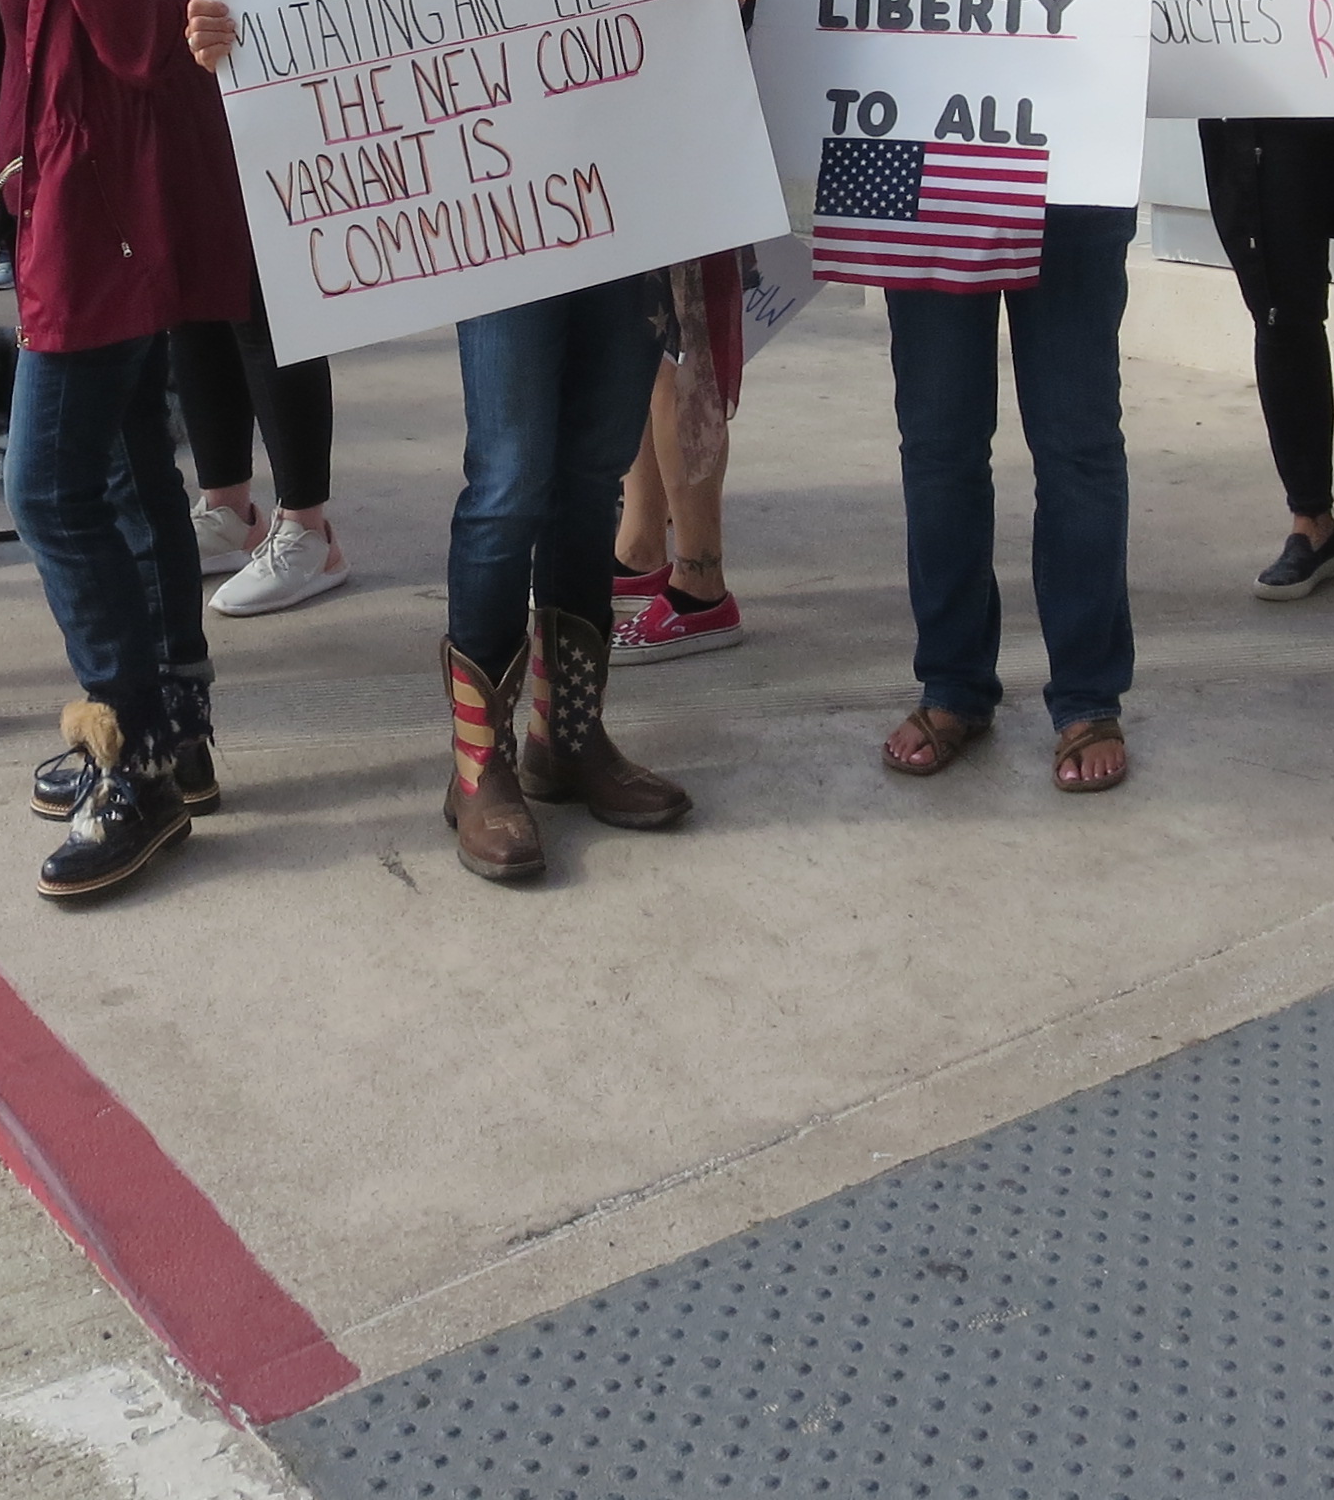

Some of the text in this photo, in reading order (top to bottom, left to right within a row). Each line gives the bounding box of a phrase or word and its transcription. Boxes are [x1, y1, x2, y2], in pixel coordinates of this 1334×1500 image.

[301, 12, 646, 144] THE NEW COVID
[825, 88, 1049, 147] TO ALL
[265, 117, 513, 225] VARIANT IS
[307, 162, 615, 298] COMMUNISM
